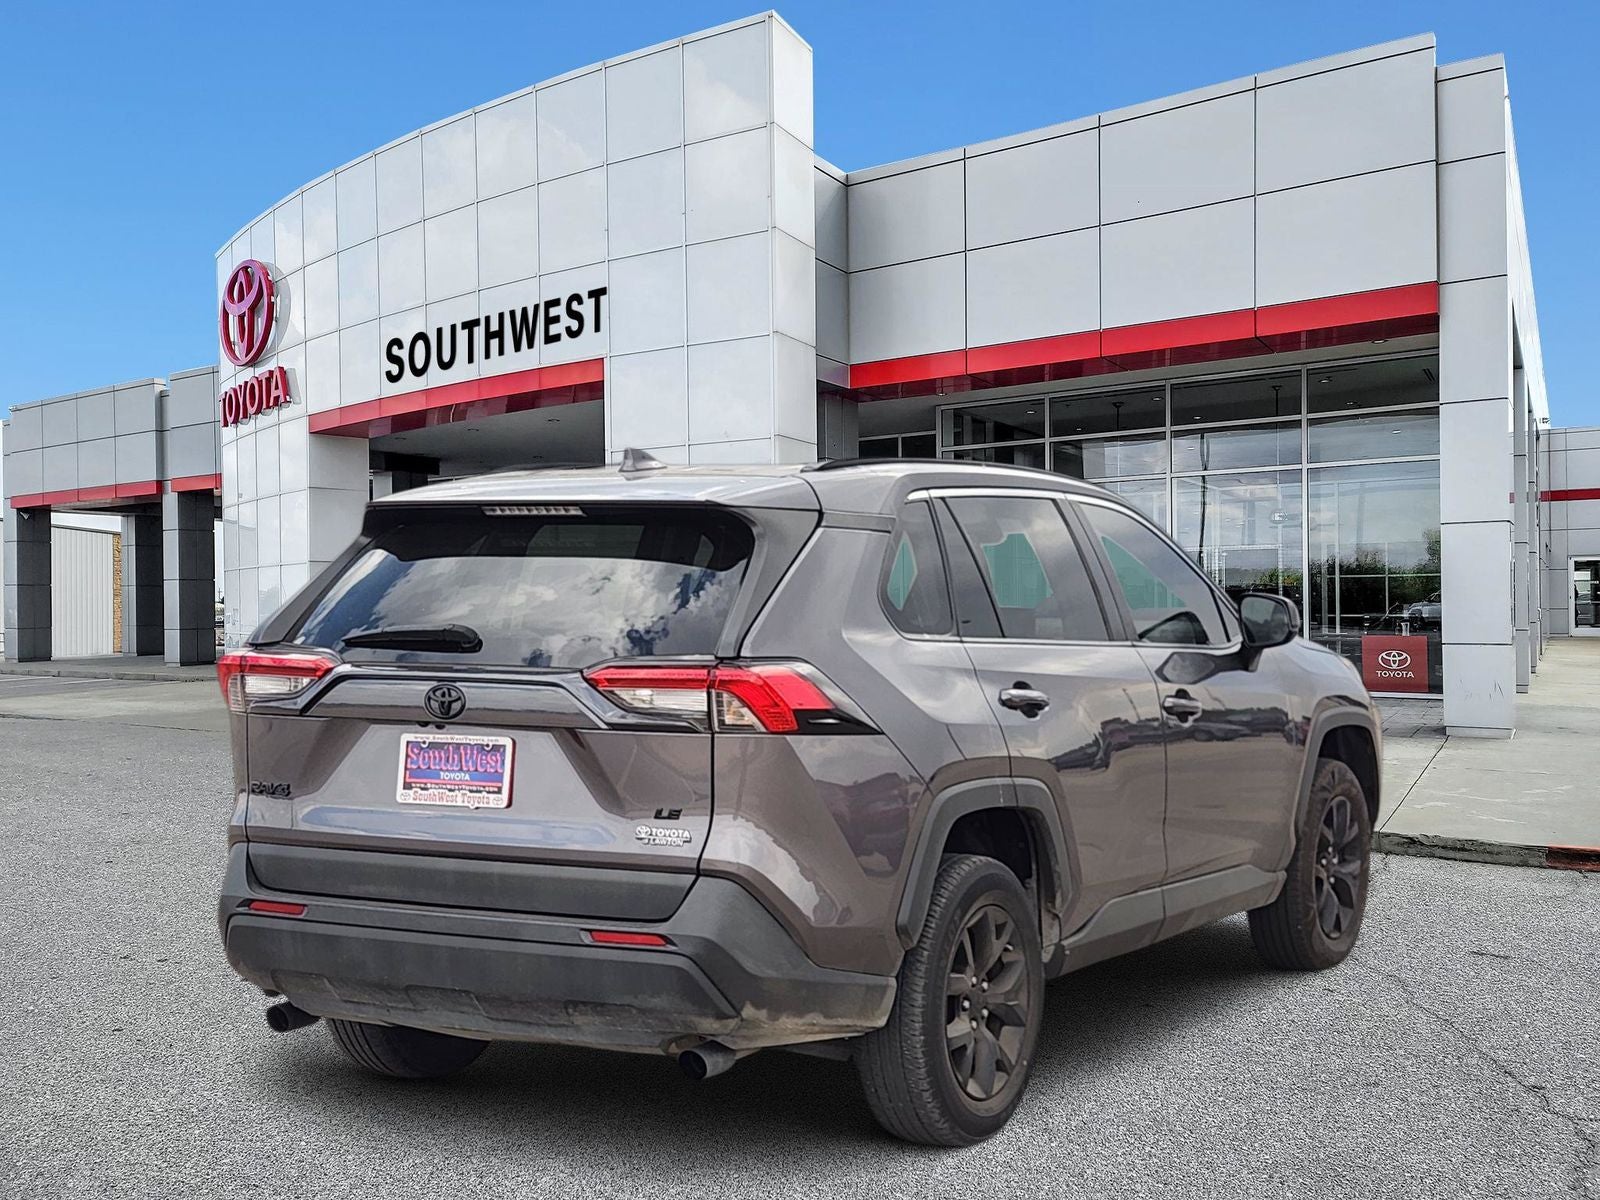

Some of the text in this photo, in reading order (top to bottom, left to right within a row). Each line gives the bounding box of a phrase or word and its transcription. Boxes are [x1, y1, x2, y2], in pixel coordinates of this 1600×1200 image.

[385, 287, 608, 384] SOUTHWEST
[219, 366, 290, 428] TOYOTA
[1375, 670, 1415, 678] TOYOTA
[440, 771, 471, 781] TOYOTA
[461, 792, 490, 806] Toyota
[653, 808, 683, 820] LE
[651, 827, 691, 838] TOYOTA
